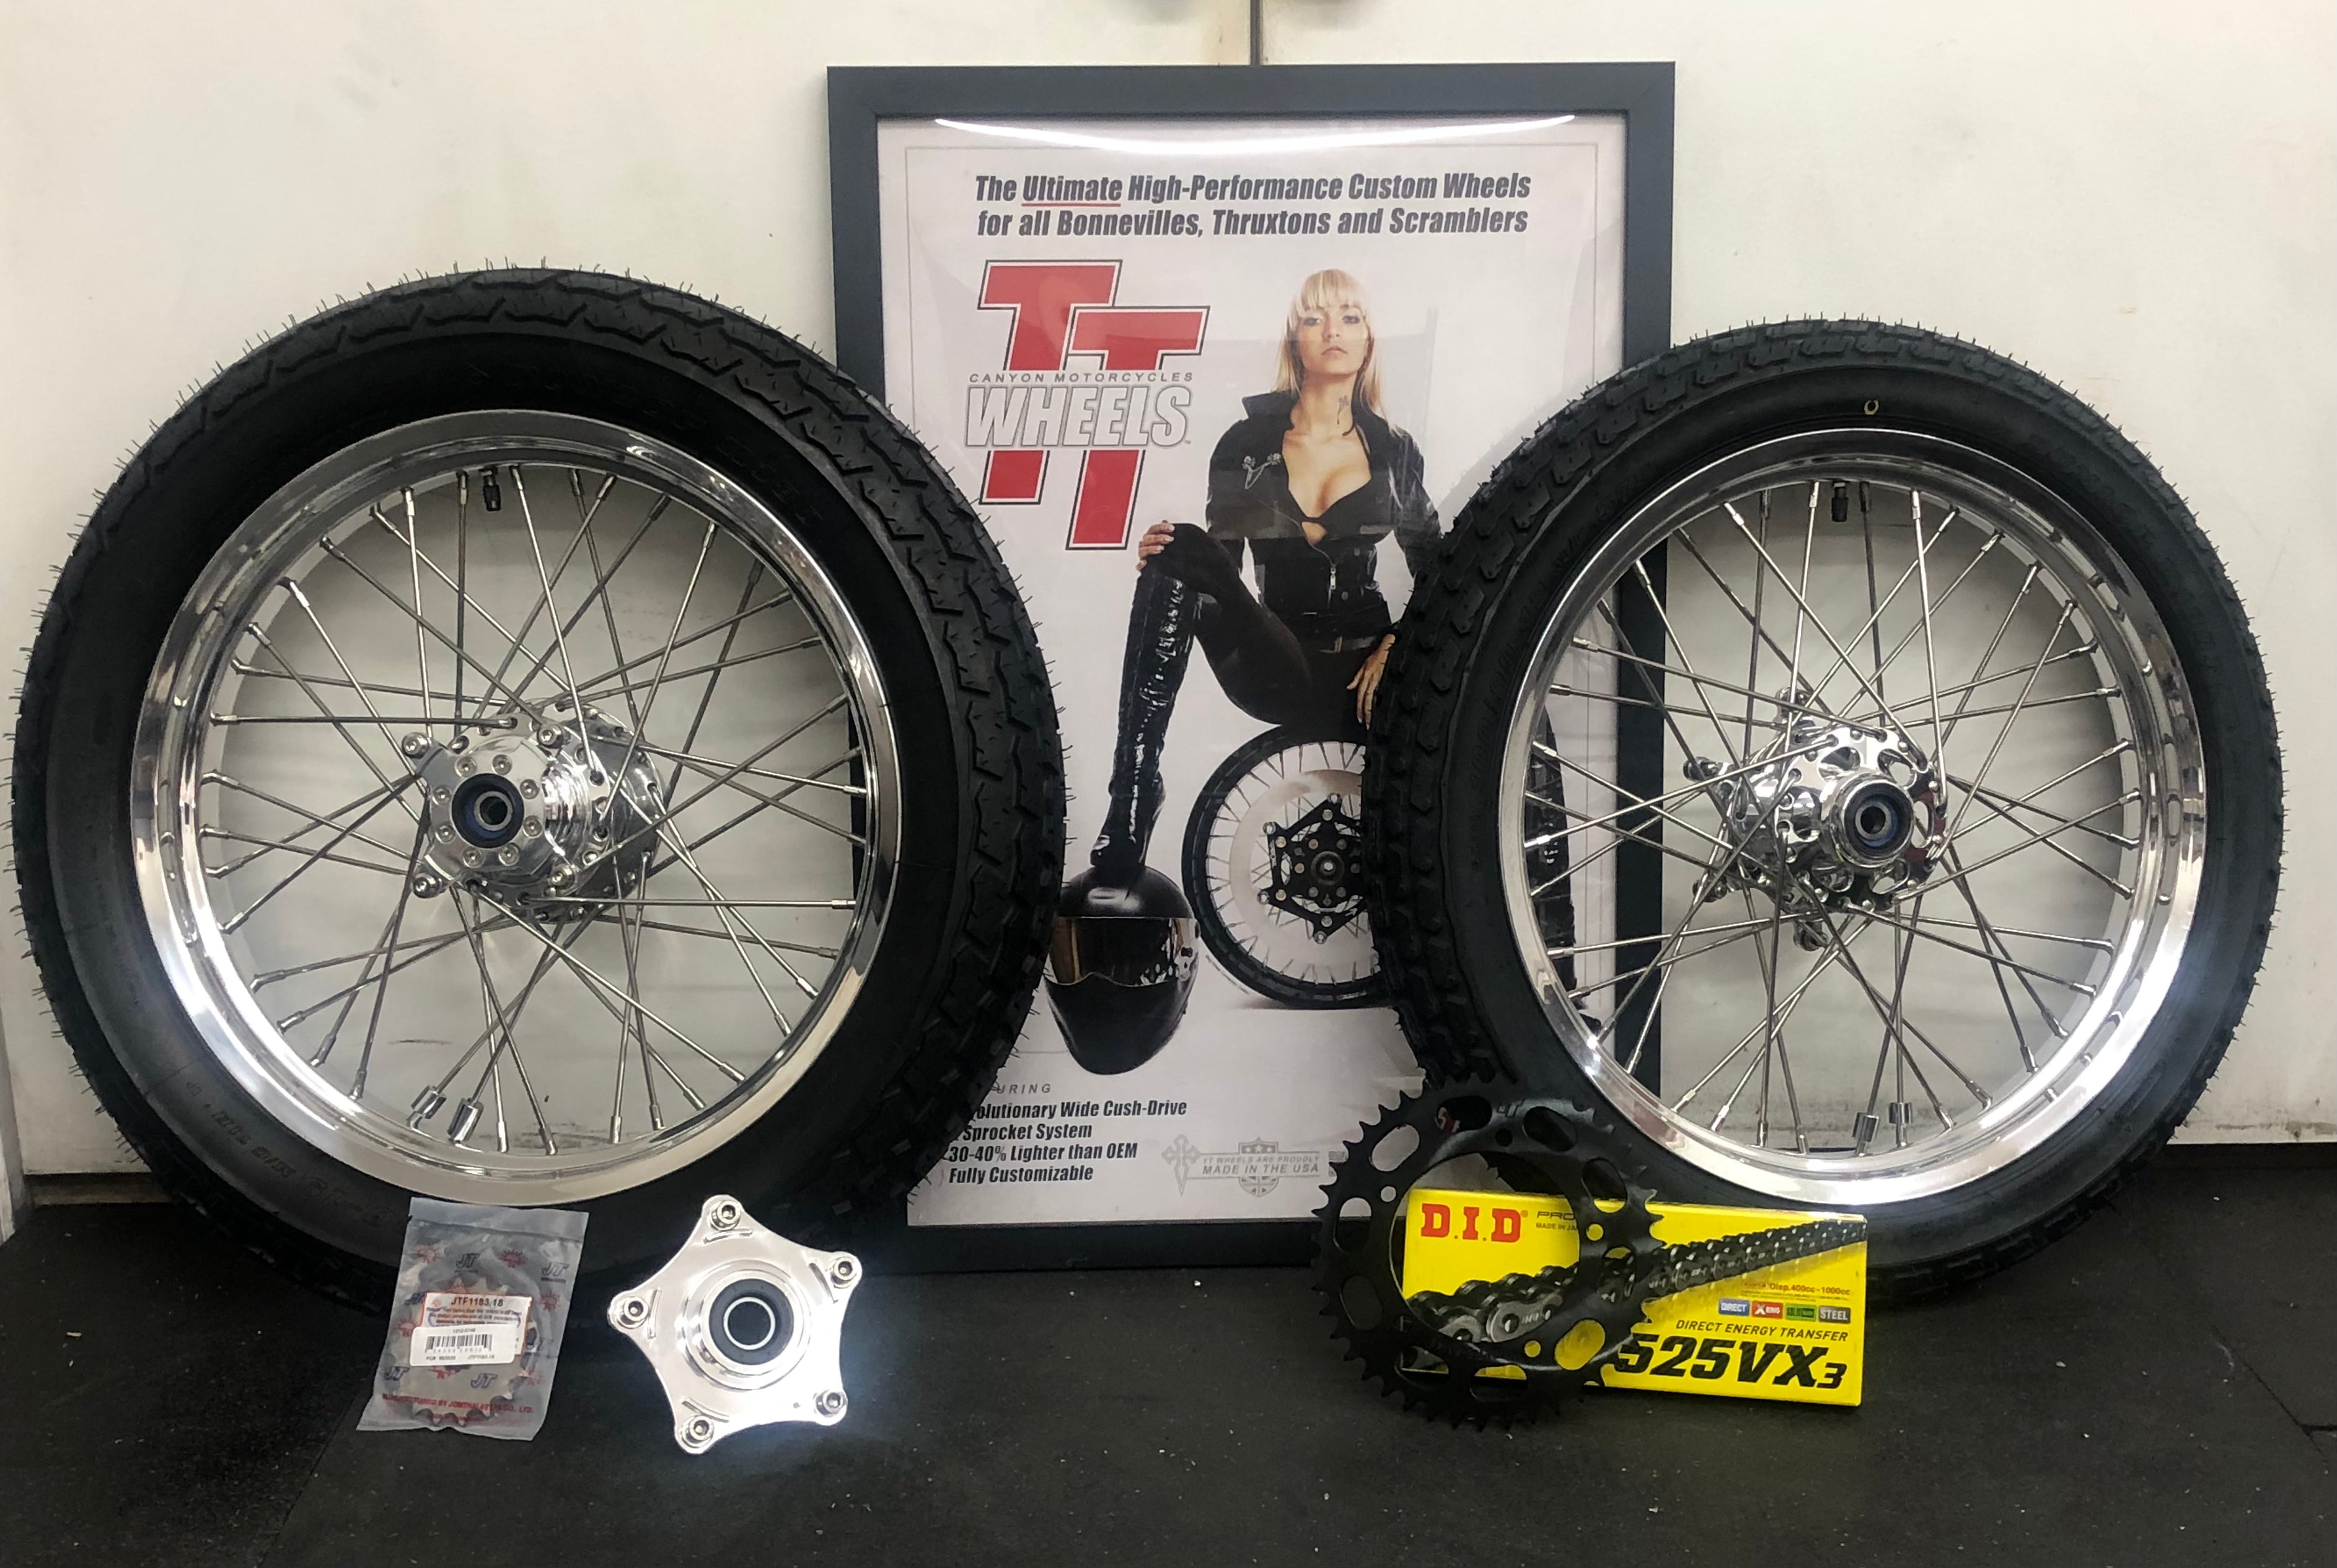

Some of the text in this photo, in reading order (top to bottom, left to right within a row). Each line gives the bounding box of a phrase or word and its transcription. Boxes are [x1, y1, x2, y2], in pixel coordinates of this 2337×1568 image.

[975, 172, 1532, 204] The Ultimate High-Performance Custom Wheels
[977, 207, 1529, 238] for all Bonnevilles, Thruxtons and Scramblers
[969, 372, 1194, 384] CANYON MOTORCYCLES
[965, 384, 1193, 449] WHEELS
[1060, 1101, 1099, 1117] Wide
[1103, 1099, 1187, 1117] Cush-Drive
[962, 1123, 1093, 1142] Sprocket System
[948, 1142, 1138, 1163] 30-40% Lighter than OEM
[1217, 1156, 1253, 1165] WHEELS
[1277, 1155, 1320, 1164] PROUDLY
[948, 1165, 1094, 1184] Fully Customizable
[1202, 1163, 1319, 1174] MADE IN THE USA
[1420, 1202, 1522, 1244] D.I.D
[1720, 1302, 1748, 1313] DIRECT
[1820, 1309, 1848, 1321] STEEL
[1675, 1319, 1849, 1342] DIRECT ENERGY TRANSFER
